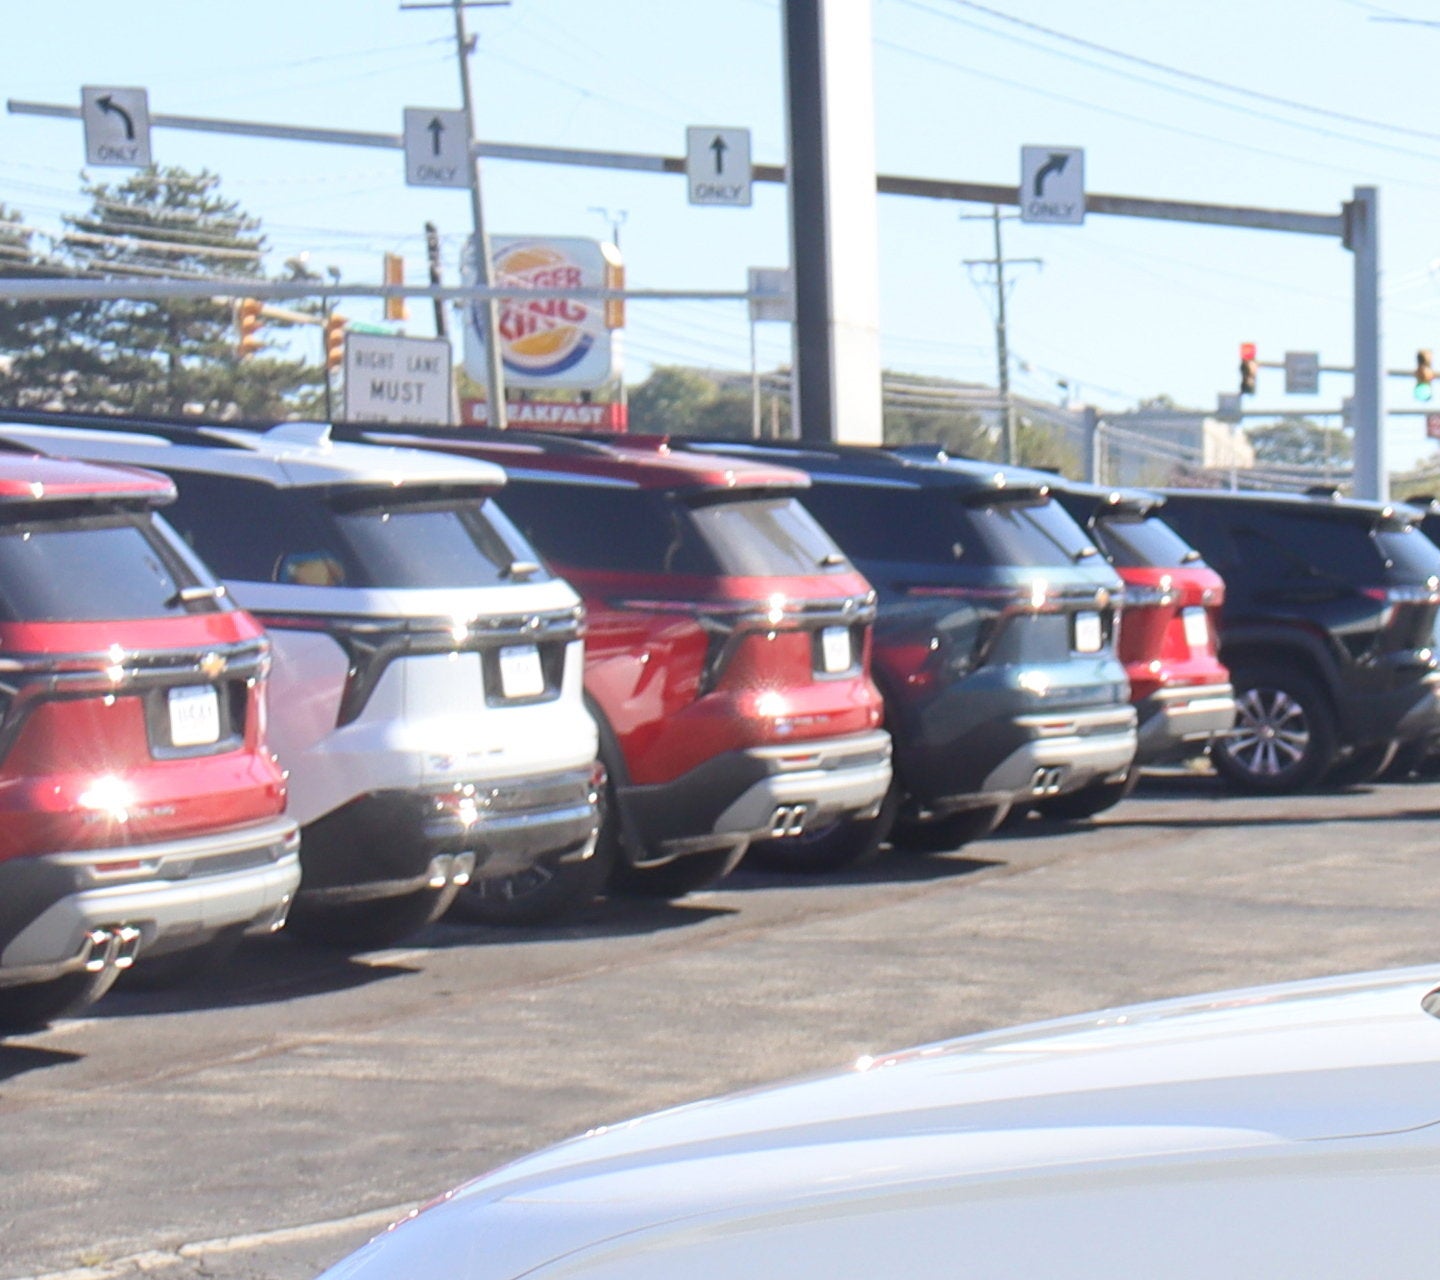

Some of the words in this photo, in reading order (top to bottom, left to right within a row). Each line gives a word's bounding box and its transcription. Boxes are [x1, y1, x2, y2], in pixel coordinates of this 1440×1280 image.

[97, 145, 138, 161] ONLY
[416, 164, 458, 181] ONLY
[696, 183, 744, 200] ONLY
[1029, 200, 1076, 217] ONLY
[370, 380, 425, 404] MUST
[472, 402, 606, 424] BEAKFAST
